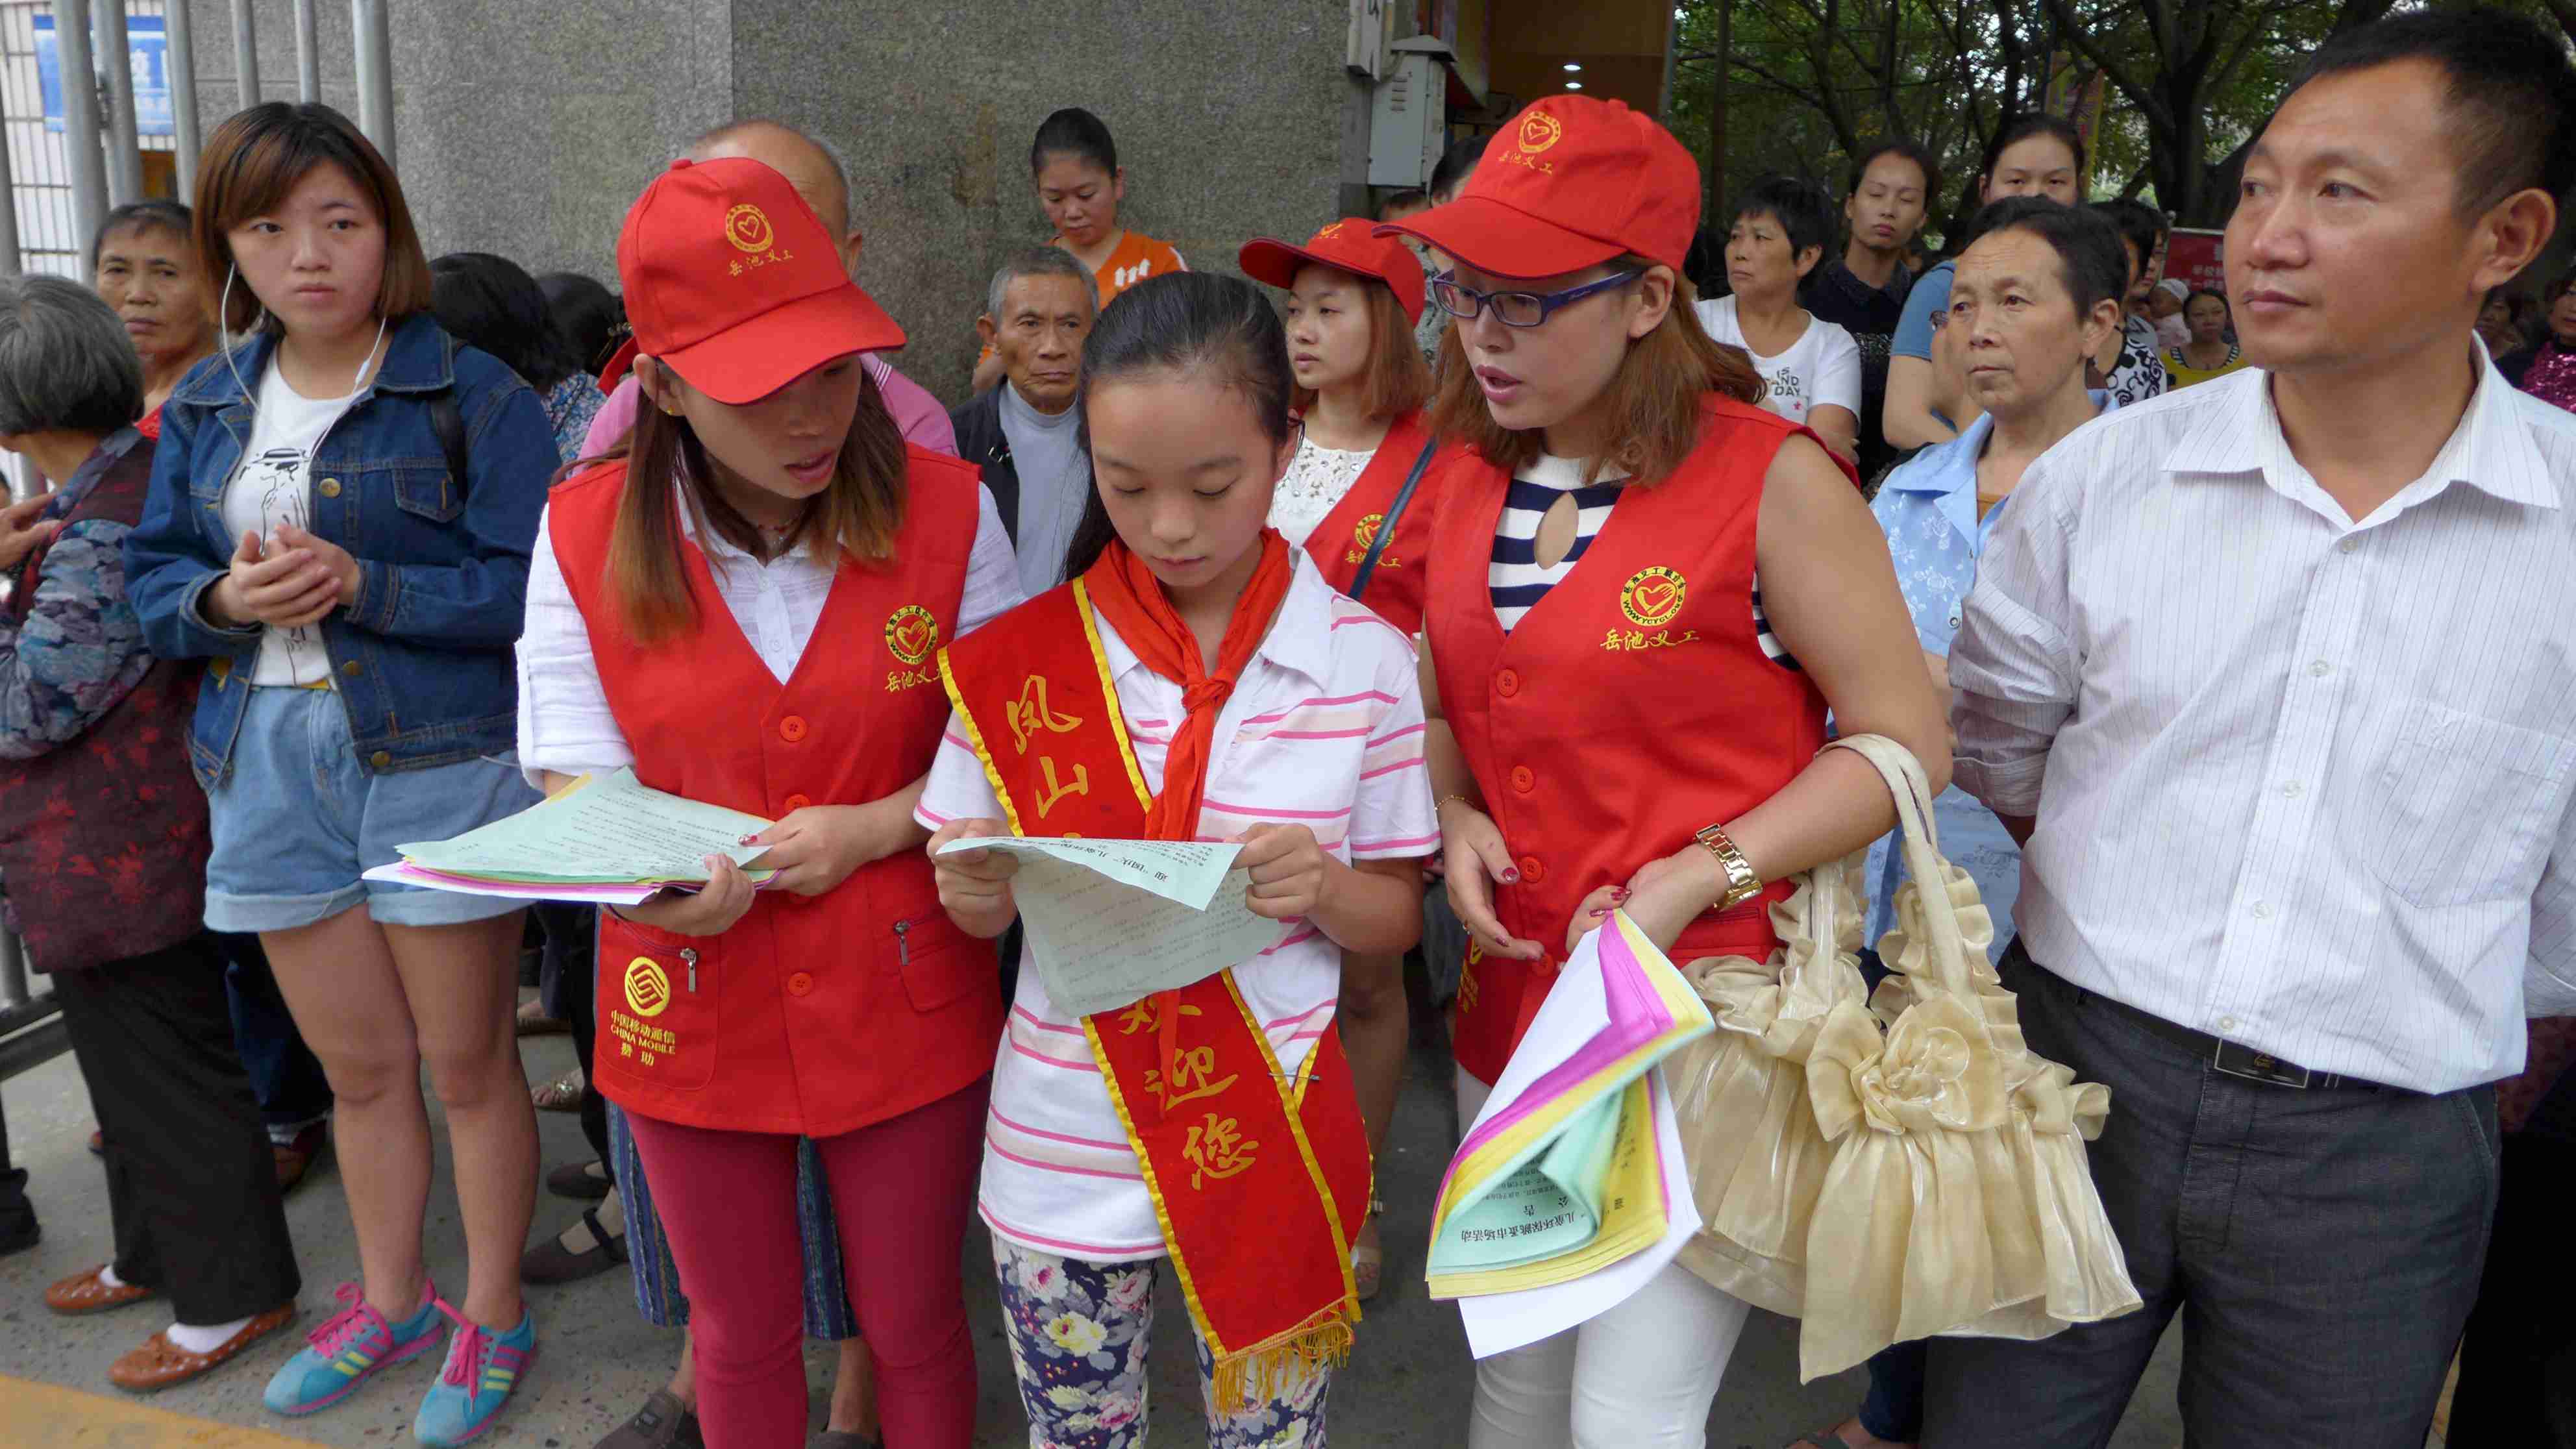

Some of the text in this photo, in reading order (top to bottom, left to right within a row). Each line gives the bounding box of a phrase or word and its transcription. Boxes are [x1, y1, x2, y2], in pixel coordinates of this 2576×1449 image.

[1775, 386, 1800, 396] DAY
[1600, 627, 1701, 650] 岳池义工
[1006, 675, 1090, 838] 凤山
[610, 1023, 676, 1055] CHINA MOBILE
